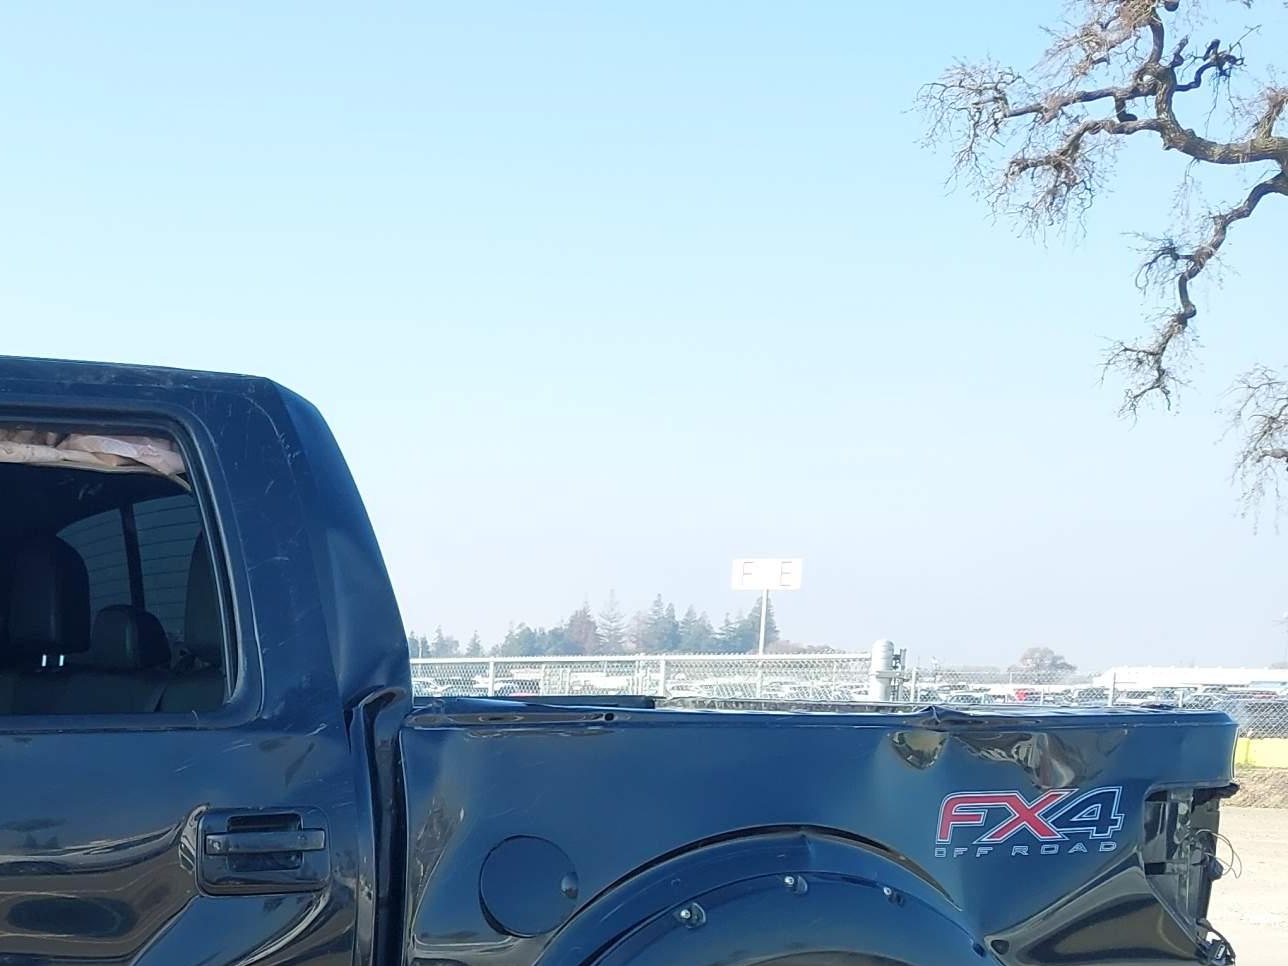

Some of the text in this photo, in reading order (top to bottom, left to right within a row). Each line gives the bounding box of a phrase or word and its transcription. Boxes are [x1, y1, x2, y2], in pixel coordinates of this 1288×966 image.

[936, 786, 1125, 845] FX4
[934, 841, 1117, 858] OFF ROAD
